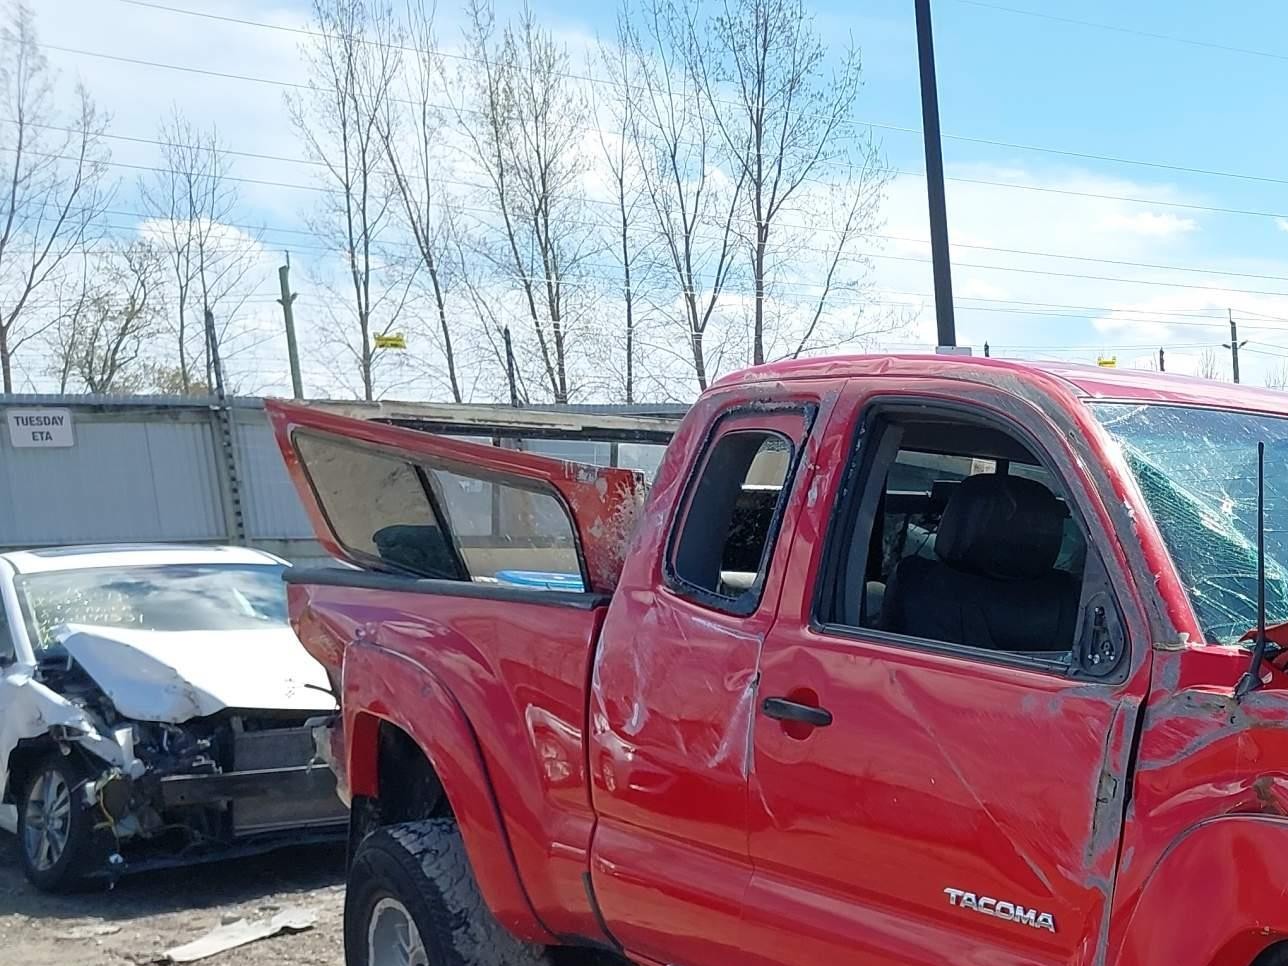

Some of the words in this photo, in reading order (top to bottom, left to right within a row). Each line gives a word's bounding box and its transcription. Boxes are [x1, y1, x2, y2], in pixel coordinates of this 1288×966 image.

[14, 415, 64, 427] TUESDAY
[31, 431, 53, 441] ETA
[943, 887, 1056, 933] TACOMA
